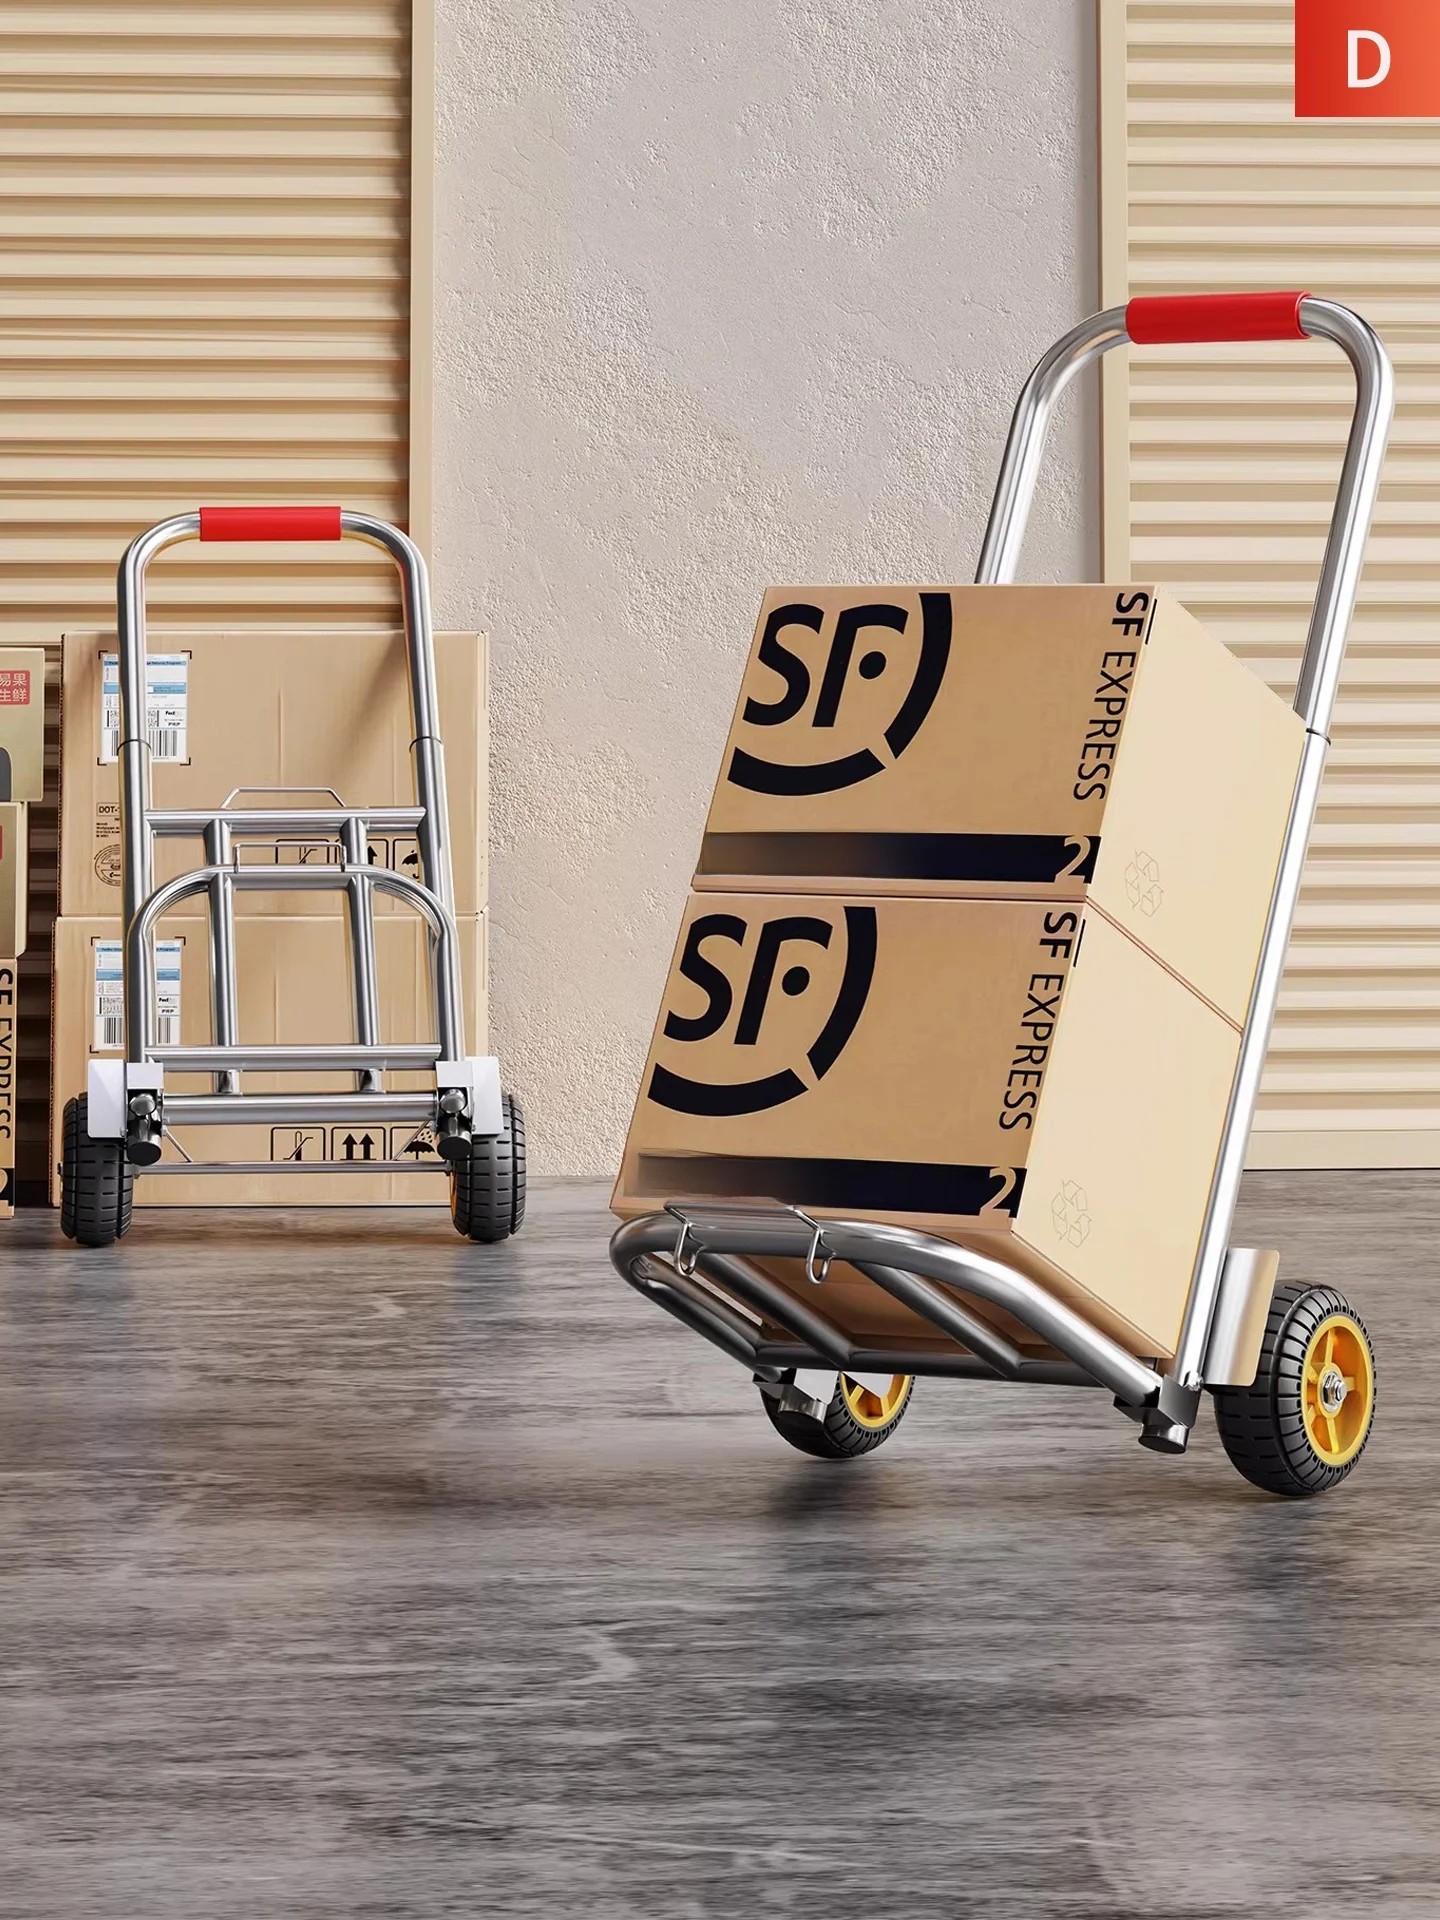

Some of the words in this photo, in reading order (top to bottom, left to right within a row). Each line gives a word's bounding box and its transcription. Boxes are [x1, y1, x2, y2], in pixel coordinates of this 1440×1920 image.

[1112, 592, 1149, 637] SF
[742, 603, 909, 728] SF
[1073, 651, 1137, 801] EXPRESS
[98, 805, 120, 814] DOT-
[1054, 835, 1090, 884] 2
[1039, 911, 1078, 960] SF
[663, 913, 834, 1046] SF
[998, 973, 1065, 1131] EXPRESS
[979, 1166, 1017, 1215] 2
